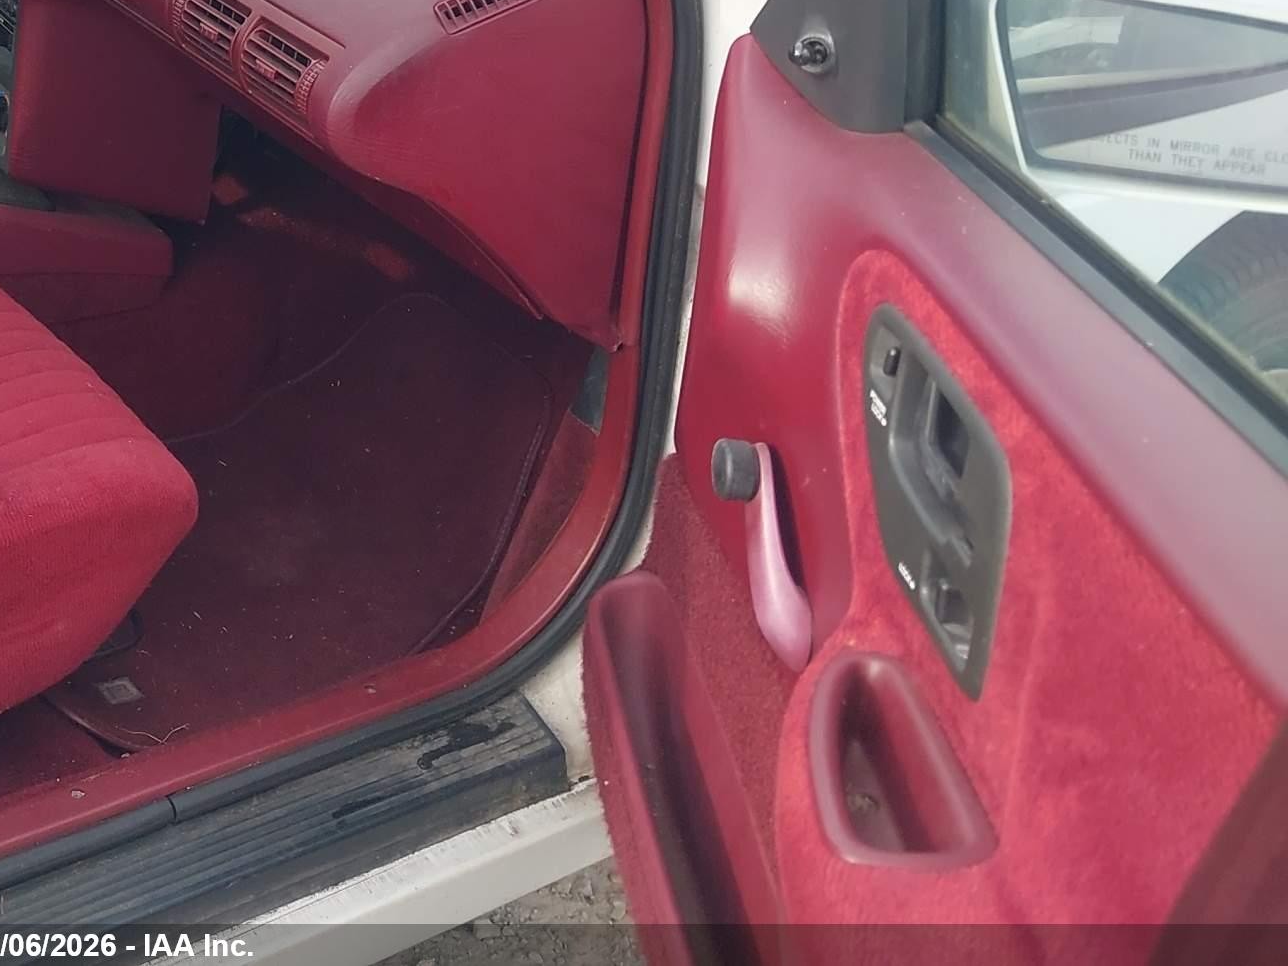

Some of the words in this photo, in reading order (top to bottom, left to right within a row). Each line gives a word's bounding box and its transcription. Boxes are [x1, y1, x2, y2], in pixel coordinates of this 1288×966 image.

[1146, 137, 1161, 148] IN
[1170, 138, 1221, 155] MIRROR
[1229, 147, 1256, 160] ARE
[1128, 148, 1161, 163] THAN
[1171, 153, 1204, 168] THEY
[1214, 159, 1266, 176] APPEAR
